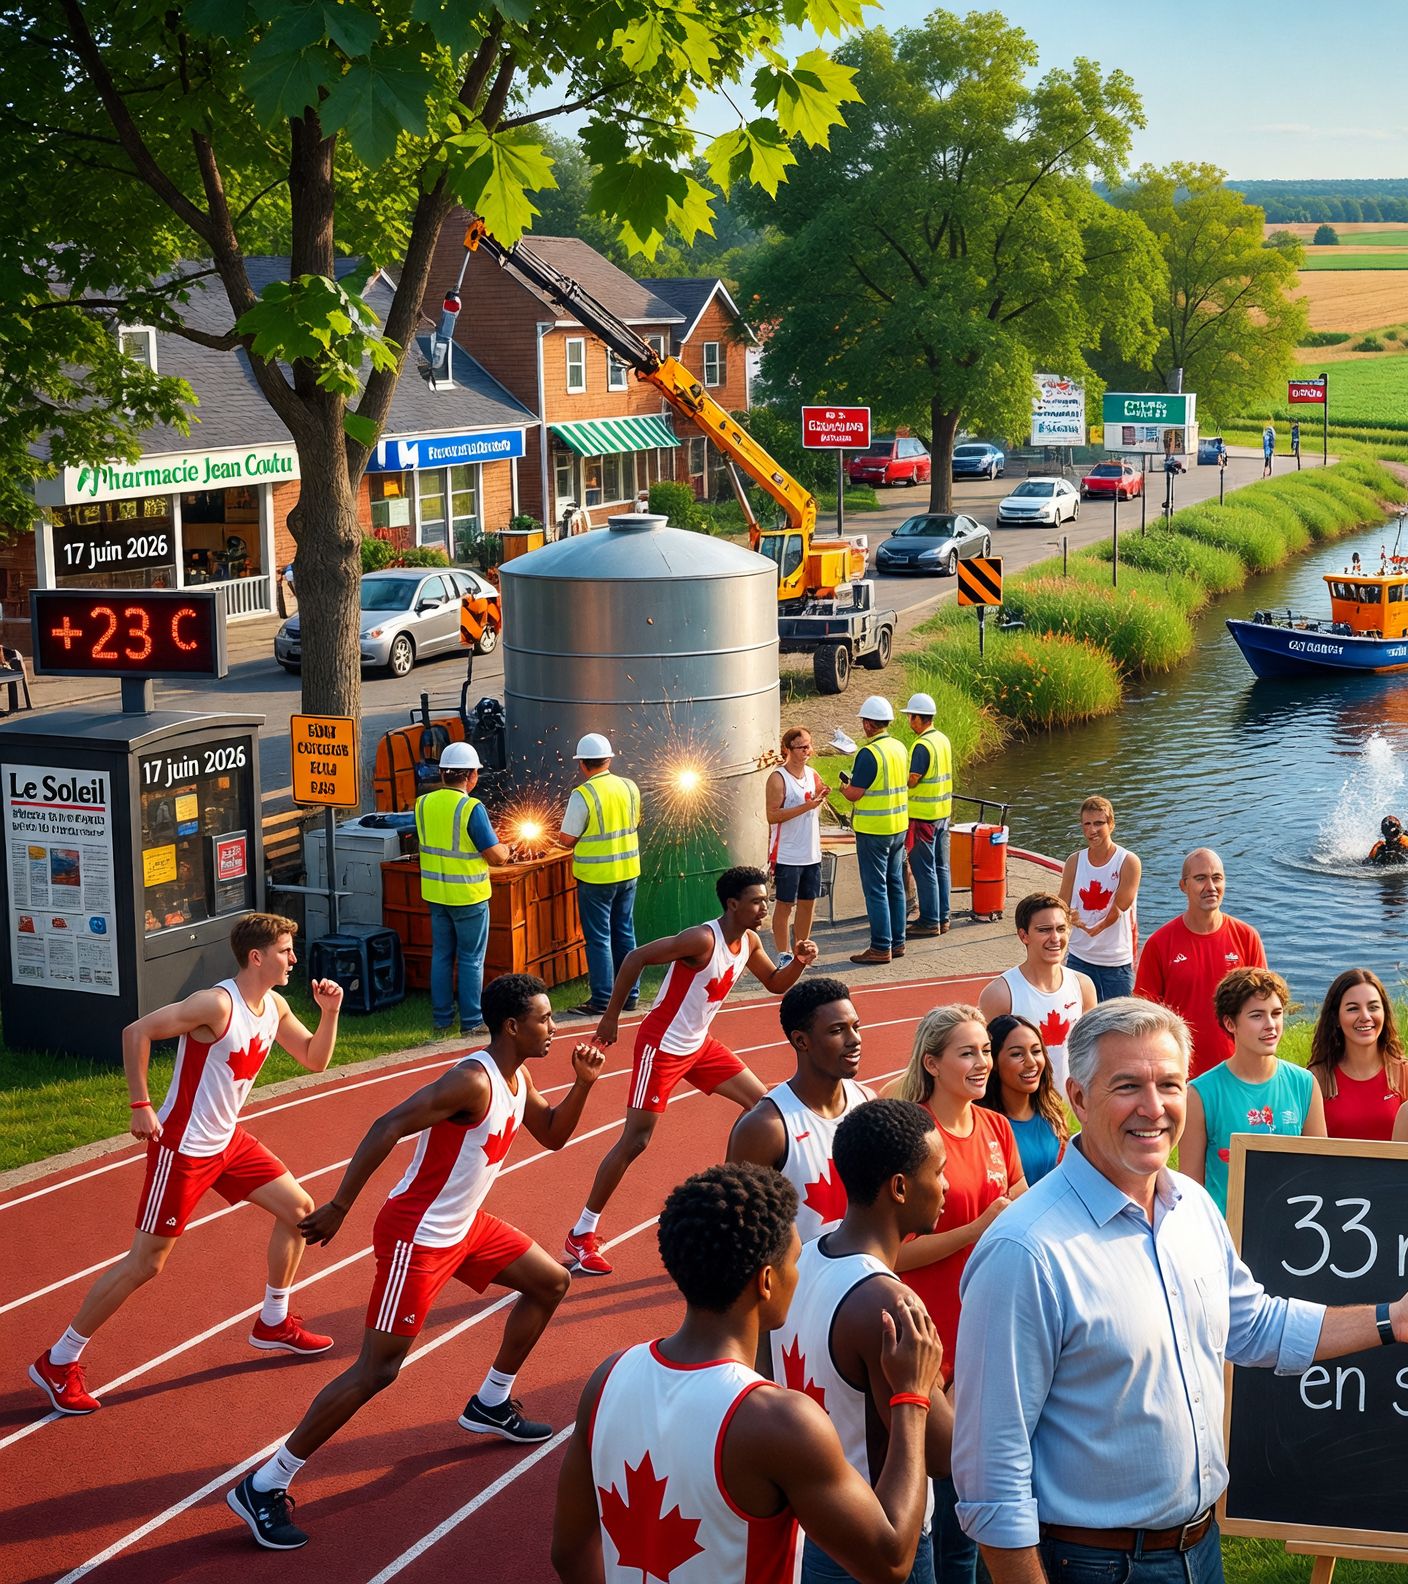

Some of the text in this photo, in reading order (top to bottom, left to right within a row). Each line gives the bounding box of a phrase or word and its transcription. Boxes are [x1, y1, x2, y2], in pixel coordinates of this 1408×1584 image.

[202, 457, 241, 484] Jean
[63, 534, 168, 570] 17 juin 2026
[51, 606, 198, 660] +23 C
[9, 772, 106, 804] Le Soleil
[142, 745, 246, 788] 17 juin 2026
[1280, 1194, 1378, 1279] 33
[1299, 1365, 1366, 1412] en
